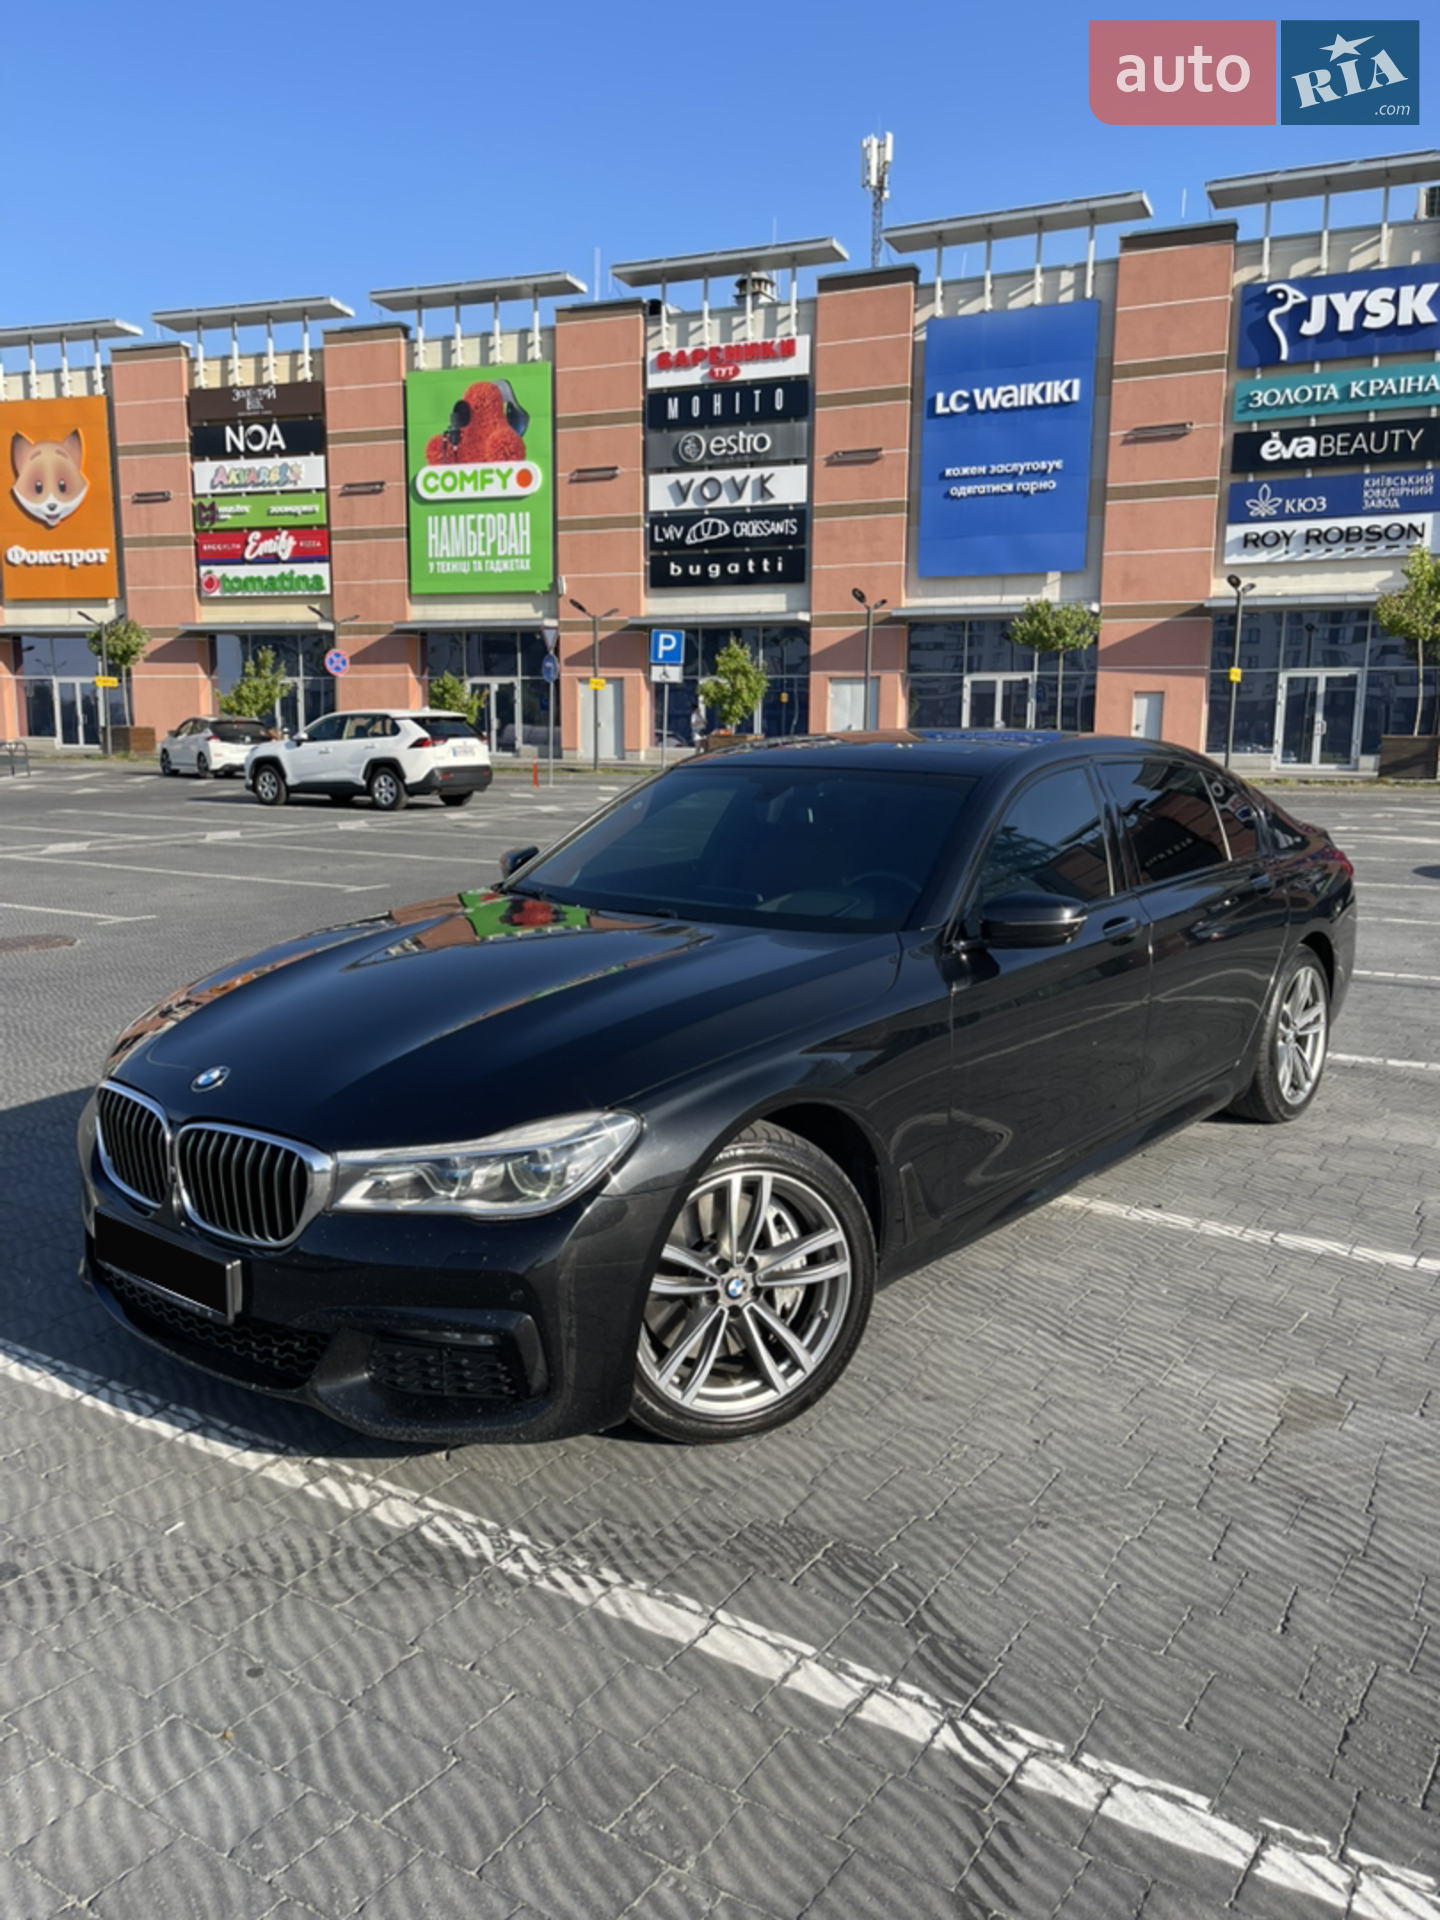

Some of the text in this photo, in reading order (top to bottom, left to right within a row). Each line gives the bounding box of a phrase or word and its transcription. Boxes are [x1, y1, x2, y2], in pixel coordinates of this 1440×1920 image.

[1299, 283, 1440, 336] JYSK
[656, 338, 796, 370] ВАРЕНИКИ
[667, 388, 783, 420] MOHITO
[935, 389, 970, 414] LC
[1248, 382, 1339, 408] ЗОЛОТА
[225, 423, 286, 453] NOA
[709, 431, 771, 456] estro
[1319, 427, 1425, 458] BEAUTY
[422, 468, 513, 493] COMFY
[945, 465, 987, 477] кожен
[676, 473, 775, 503] VOVK
[1284, 496, 1327, 514] КЮЗ
[244, 530, 297, 560] Emily
[427, 512, 530, 558] НАМБЕРВАН
[1243, 521, 1426, 549] ROY ROBSON
[6, 545, 110, 567] Фокстрот
[669, 557, 783, 577] bugatti
[220, 569, 325, 592] tomatina
[658, 633, 676, 659] P
